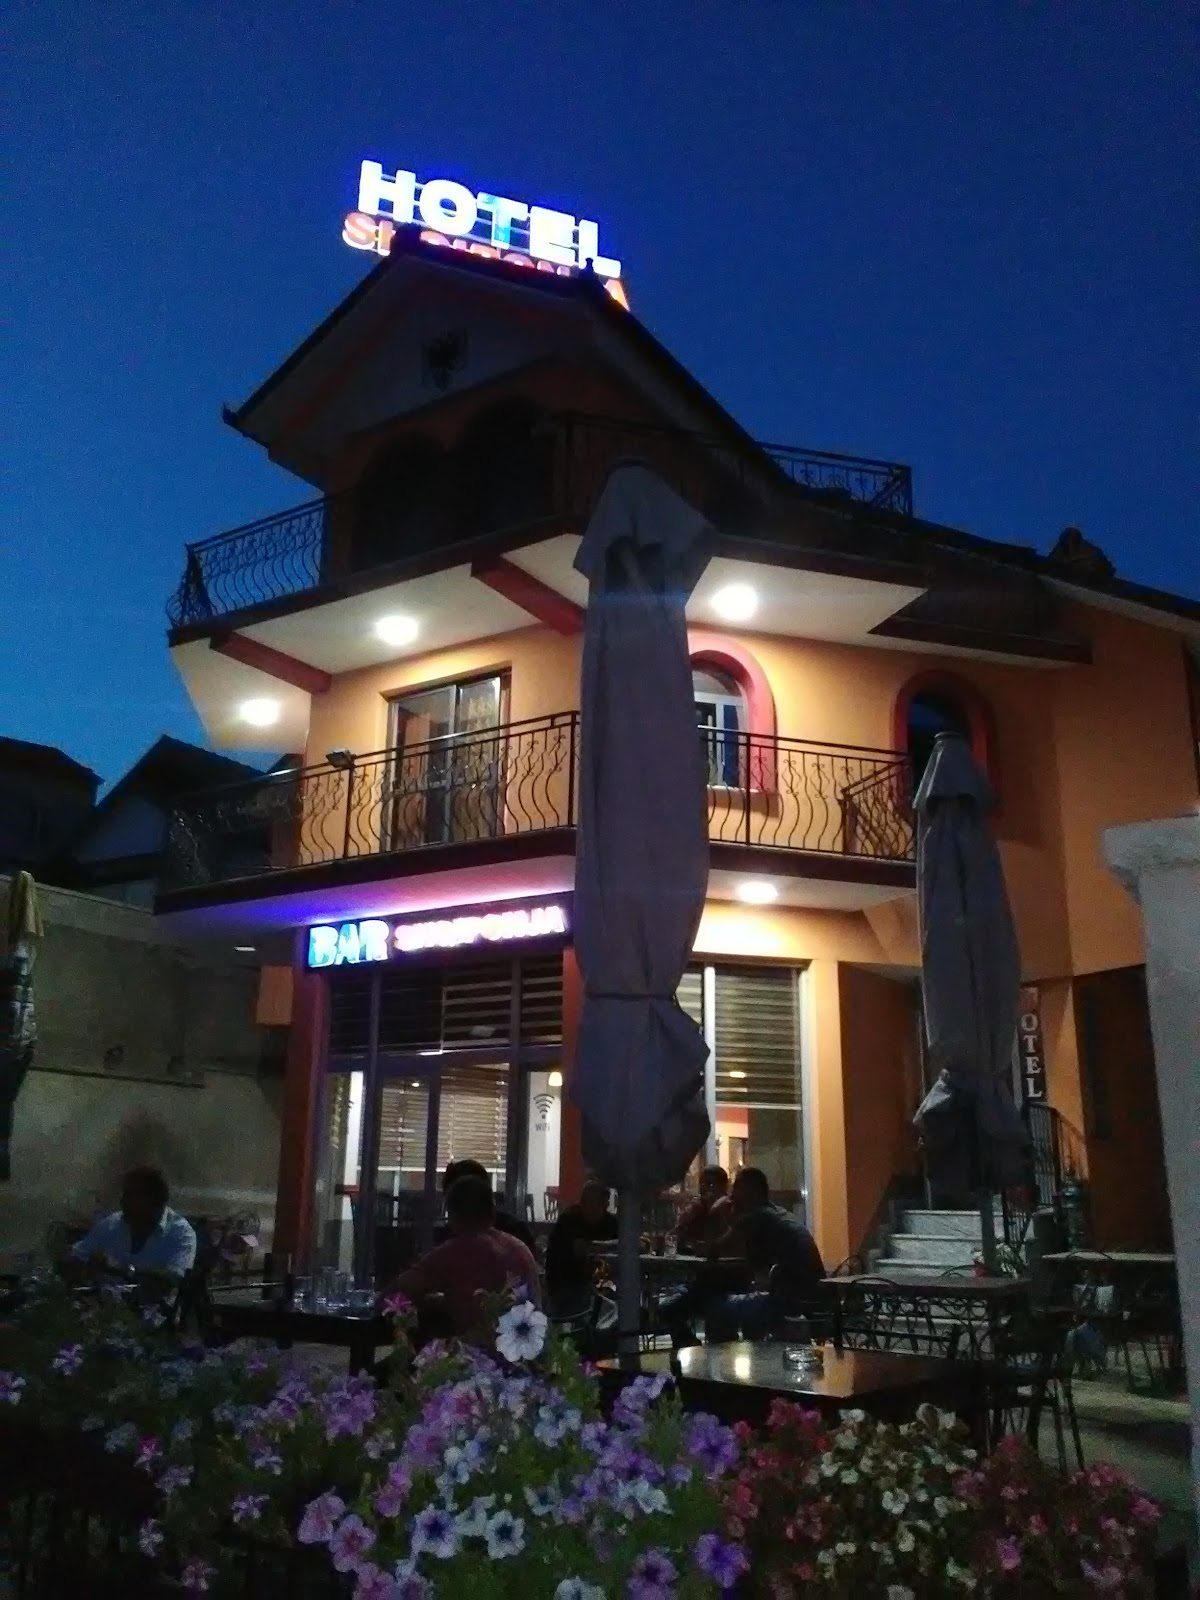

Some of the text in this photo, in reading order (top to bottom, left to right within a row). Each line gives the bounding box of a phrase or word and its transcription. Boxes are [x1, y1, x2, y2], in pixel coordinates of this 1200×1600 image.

[358, 159, 621, 277] HOTEL
[308, 919, 389, 968] BAR
[1020, 1008, 1043, 1098] OTEL
